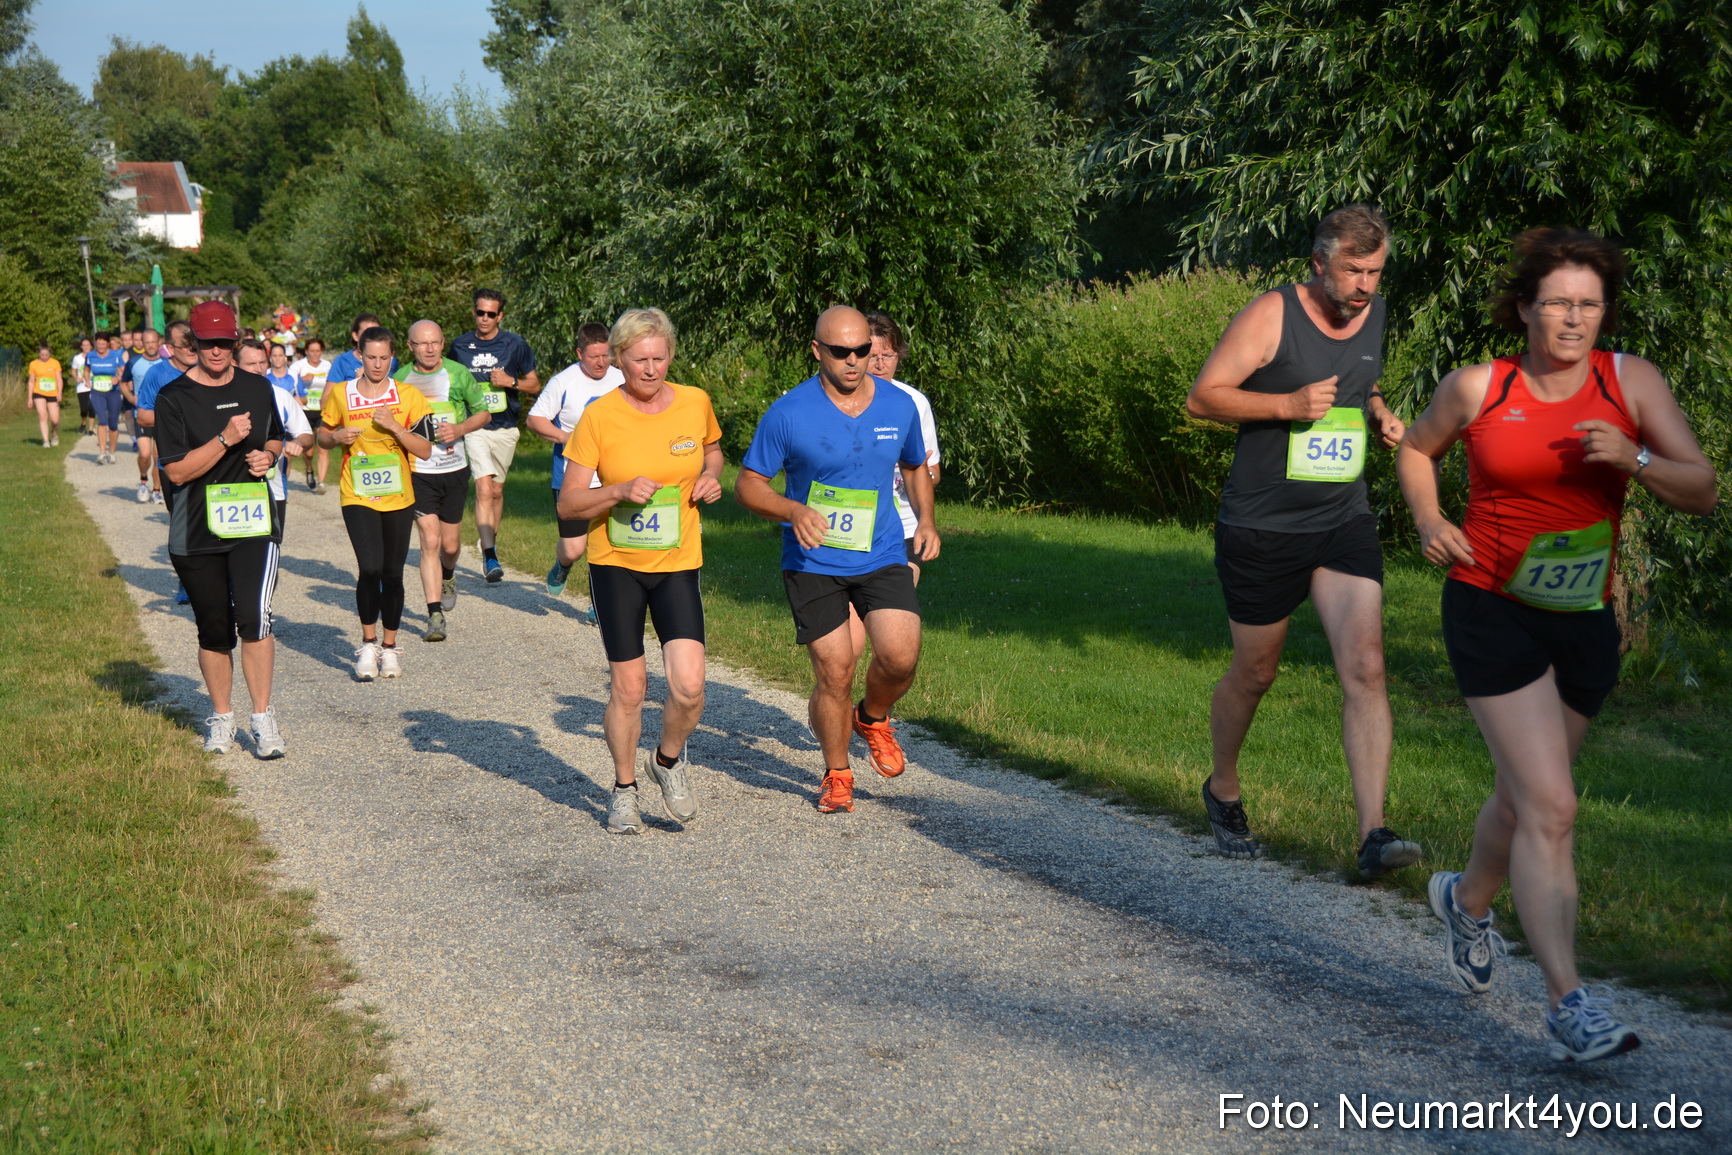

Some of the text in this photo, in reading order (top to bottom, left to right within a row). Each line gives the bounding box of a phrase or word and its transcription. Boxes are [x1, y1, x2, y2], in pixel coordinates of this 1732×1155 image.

[349, 412, 372, 421] MAX
[1306, 437, 1352, 461] 545
[362, 471, 392, 485] 892
[215, 504, 264, 523] 1214
[630, 513, 660, 532] 64
[827, 512, 853, 532] 18
[1528, 558, 1603, 589] 1377
